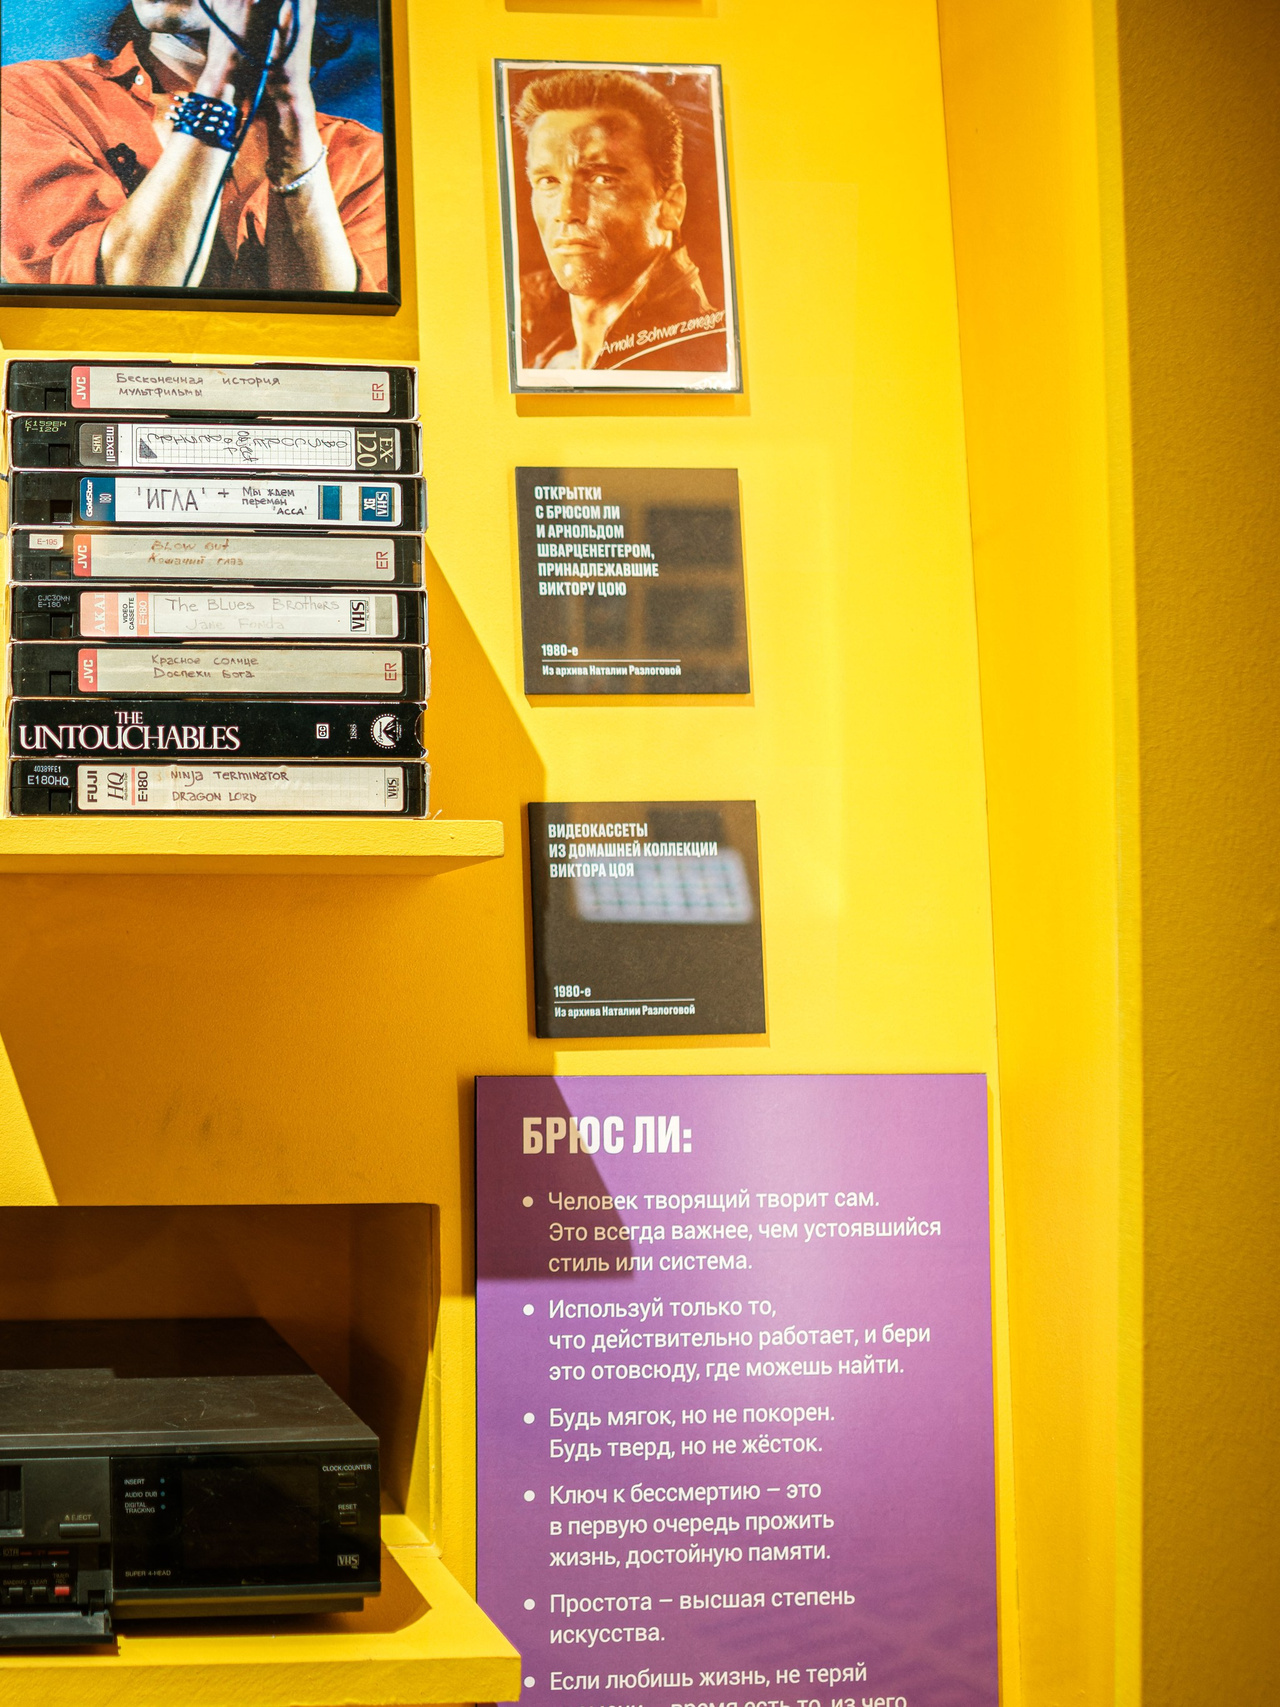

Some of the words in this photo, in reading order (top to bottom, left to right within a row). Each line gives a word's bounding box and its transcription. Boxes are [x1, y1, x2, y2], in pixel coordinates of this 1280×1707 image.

[599, 334, 634, 356] Arnold
[636, 310, 725, 345] Schwarzenegger
[76, 377, 86, 399] JVC
[116, 373, 203, 384] Бесконечная
[223, 377, 280, 387] история
[372, 384, 384, 400] ER
[106, 426, 115, 461] maxell
[357, 431, 377, 467] 120
[380, 437, 393, 463] EX-
[242, 487, 261, 496] Мы
[535, 486, 601, 500] ОТКРЫТКИ
[377, 493, 387, 515] VHS
[536, 505, 545, 519] С
[547, 506, 602, 520] БРЮСОМ
[603, 506, 620, 520] ЛИ
[536, 525, 545, 538] И
[548, 525, 624, 540] АРНОЛЬДОМ
[78, 545, 87, 568] JVC
[376, 552, 388, 569] ER
[537, 544, 654, 560] ШВАРЦЕНЕГГЕРОМ,
[538, 563, 659, 578] ПРИНАДЛЕЖАВШИЕ
[539, 582, 595, 596] ВИКТОРУ
[598, 582, 626, 597] ЦОЮ
[95, 593, 105, 633] AKAI
[139, 601, 147, 625] E-180
[165, 598, 199, 611] The
[352, 602, 365, 629] VHS
[152, 655, 201, 665] Красное
[214, 657, 259, 666] солнце
[541, 644, 578, 656] 1980-е
[84, 660, 93, 683] JVC
[385, 663, 396, 681] ER
[542, 665, 554, 675] Из
[556, 667, 588, 677] архива
[590, 666, 627, 675] Наталии
[629, 665, 681, 675] Разлоговой
[115, 712, 143, 724] THE
[19, 726, 240, 751] UNTOUCHABLES
[28, 775, 69, 785] E180HQ
[88, 771, 97, 802] FUJI
[107, 772, 124, 800] HQ
[138, 771, 148, 801] E-180
[229, 793, 257, 802] LORD
[549, 823, 647, 839] ВИДЕОКАССЕТЫ
[549, 844, 566, 857] ИЗ
[569, 840, 641, 859] ДОМАШНЕЙ
[643, 842, 717, 857] КОЛЛЕКЦИИ
[550, 864, 606, 878] ВИКТОРА
[609, 863, 634, 879] ЦОЯ
[554, 985, 591, 997] 1980-е
[555, 1007, 567, 1017] Из
[568, 1008, 601, 1018] архива
[602, 1006, 640, 1016] Наталии
[642, 1004, 695, 1016] Разлоговой
[522, 1116, 624, 1154] БРЮС
[633, 1116, 692, 1154] ЛИ:
[549, 1192, 638, 1210] Человек
[644, 1189, 751, 1213] творящий
[756, 1193, 828, 1212] творит
[835, 1192, 879, 1207] сам.
[550, 1223, 587, 1241] Это
[595, 1225, 665, 1244] всегда
[672, 1224, 752, 1241] важнее,
[759, 1224, 797, 1238] чем
[804, 1217, 940, 1242] устоявшийся
[549, 1258, 609, 1272] стиль
[617, 1256, 653, 1271] или
[660, 1255, 752, 1270] система.
[550, 1297, 663, 1322] Используй
[670, 1301, 742, 1316] только
[748, 1301, 776, 1317] то,
[550, 1335, 585, 1349] что
[592, 1329, 753, 1352] действительно
[760, 1325, 858, 1350] работает,
[865, 1329, 876, 1343] и
[883, 1323, 930, 1347] бери
[550, 1366, 585, 1380] это
[592, 1363, 700, 1382] отовсюду,
[707, 1363, 740, 1381] где
[747, 1361, 832, 1376] можешь
[839, 1354, 903, 1374] найти.
[551, 1408, 601, 1431] Будь
[608, 1410, 675, 1427] мягок,
[682, 1410, 706, 1424] но
[713, 1409, 736, 1423] не
[744, 1407, 834, 1426] покорен.
[551, 1439, 601, 1462] Будь
[608, 1441, 675, 1460] тверд,
[682, 1440, 706, 1454] но
[713, 1440, 736, 1454] не
[742, 1434, 822, 1453] жёсток.
[551, 1486, 606, 1504] Ключ
[614, 1489, 625, 1502] к
[631, 1483, 760, 1505] бессмертию
[787, 1484, 821, 1498] это
[551, 1521, 562, 1535] в
[569, 1519, 647, 1539] первую
[653, 1517, 739, 1536] очередь
[746, 1514, 834, 1534] прожить
[339, 1555, 358, 1565] VHS
[550, 1551, 620, 1567] жизнь,
[626, 1544, 742, 1568] достойную
[749, 1545, 830, 1561] памяти.
[551, 1594, 651, 1617] Простота
[680, 1593, 764, 1609] высшая
[772, 1591, 855, 1607] степень
[551, 1627, 664, 1647] искусства.
[551, 1672, 599, 1690] Если
[605, 1668, 693, 1688] любишь
[700, 1671, 770, 1687] жизнь,
[777, 1669, 800, 1683] не
[806, 1662, 866, 1687] теряй
